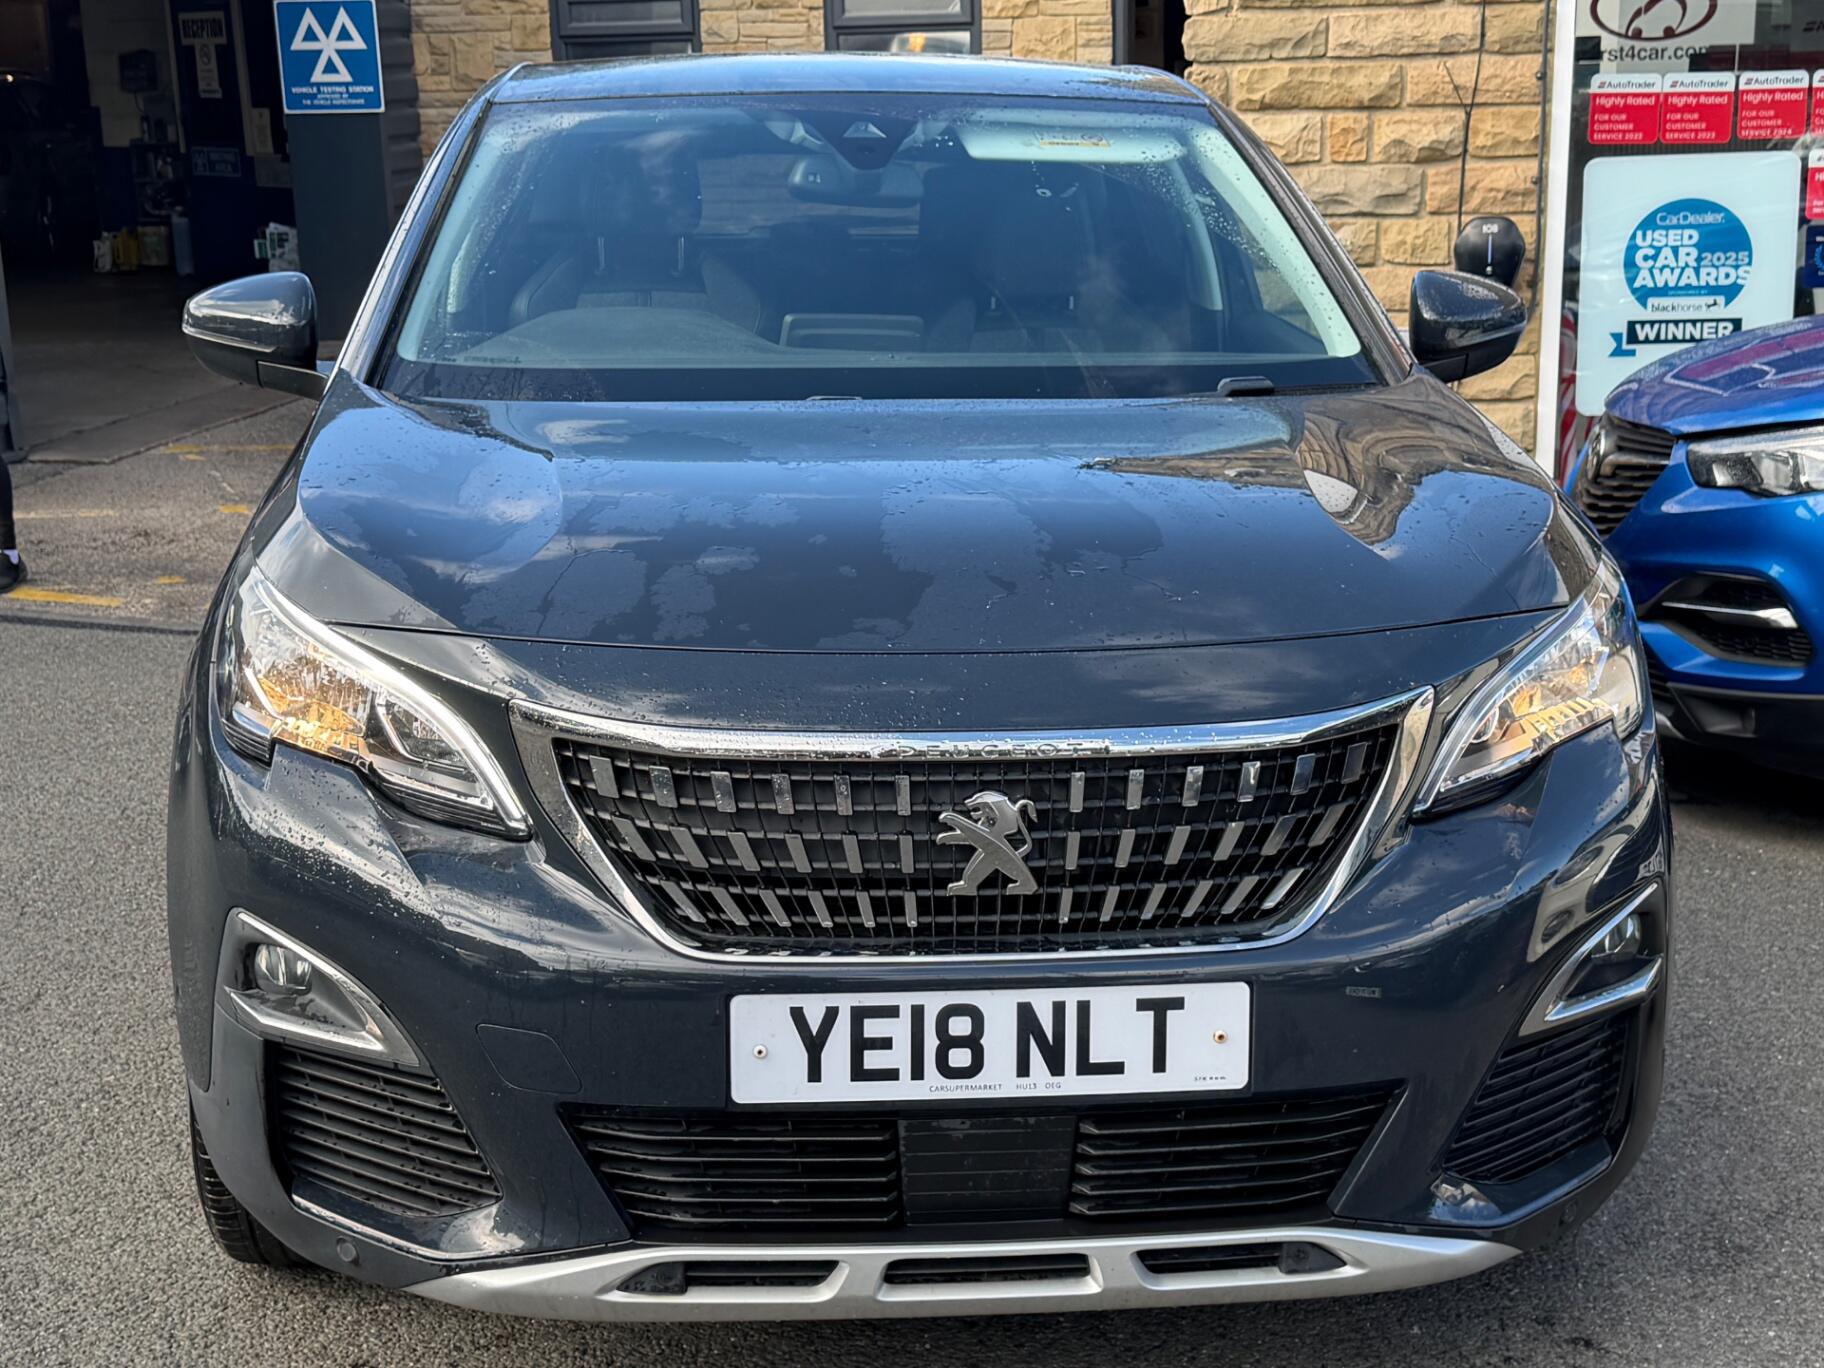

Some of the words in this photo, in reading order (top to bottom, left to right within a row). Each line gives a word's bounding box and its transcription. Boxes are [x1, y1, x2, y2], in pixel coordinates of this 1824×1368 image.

[182, 18, 223, 38] RECEPTION
[1606, 81, 1656, 89] AutoTrader
[1679, 80, 1728, 88] AutoTrader
[1754, 76, 1804, 85] AutoTrader
[291, 86, 317, 94] VEHICLE
[320, 85, 346, 93] TESTING
[348, 85, 374, 93] STATION
[1596, 96, 1625, 108] Highly
[1627, 95, 1655, 106] Rated
[1668, 95, 1698, 108] Highly
[1699, 95, 1728, 105] Rated
[1743, 91, 1774, 104] Highly
[1775, 91, 1803, 101] Rated
[1594, 113, 1609, 121] FOR
[1610, 113, 1627, 121] OUR
[1666, 112, 1681, 121] FOR
[1682, 112, 1699, 121] OUR
[1742, 109, 1757, 117] FOR
[1758, 109, 1775, 117] OUR
[1594, 122, 1634, 131] CUSTOMER
[1666, 121, 1706, 130] CUSTOMER
[1741, 118, 1782, 128] CUSTOMER
[1593, 132, 1623, 140] SERVICE
[1665, 131, 1695, 140] SERVICE
[1635, 229, 1699, 247] USED
[1635, 247, 1699, 269] CAR
[1700, 251, 1749, 266] 2025
[1633, 266, 1752, 288] AWARDS
[1651, 301, 1703, 312] blackhorse
[1635, 321, 1734, 341] WINNER
[898, 742, 1083, 759] PEUGEOT
[789, 1003, 985, 1083] YE18
[1016, 996, 1185, 1077] NLT
[929, 1084, 1002, 1093] CARSUPERMARKET
[1016, 1082, 1037, 1090] HU13
